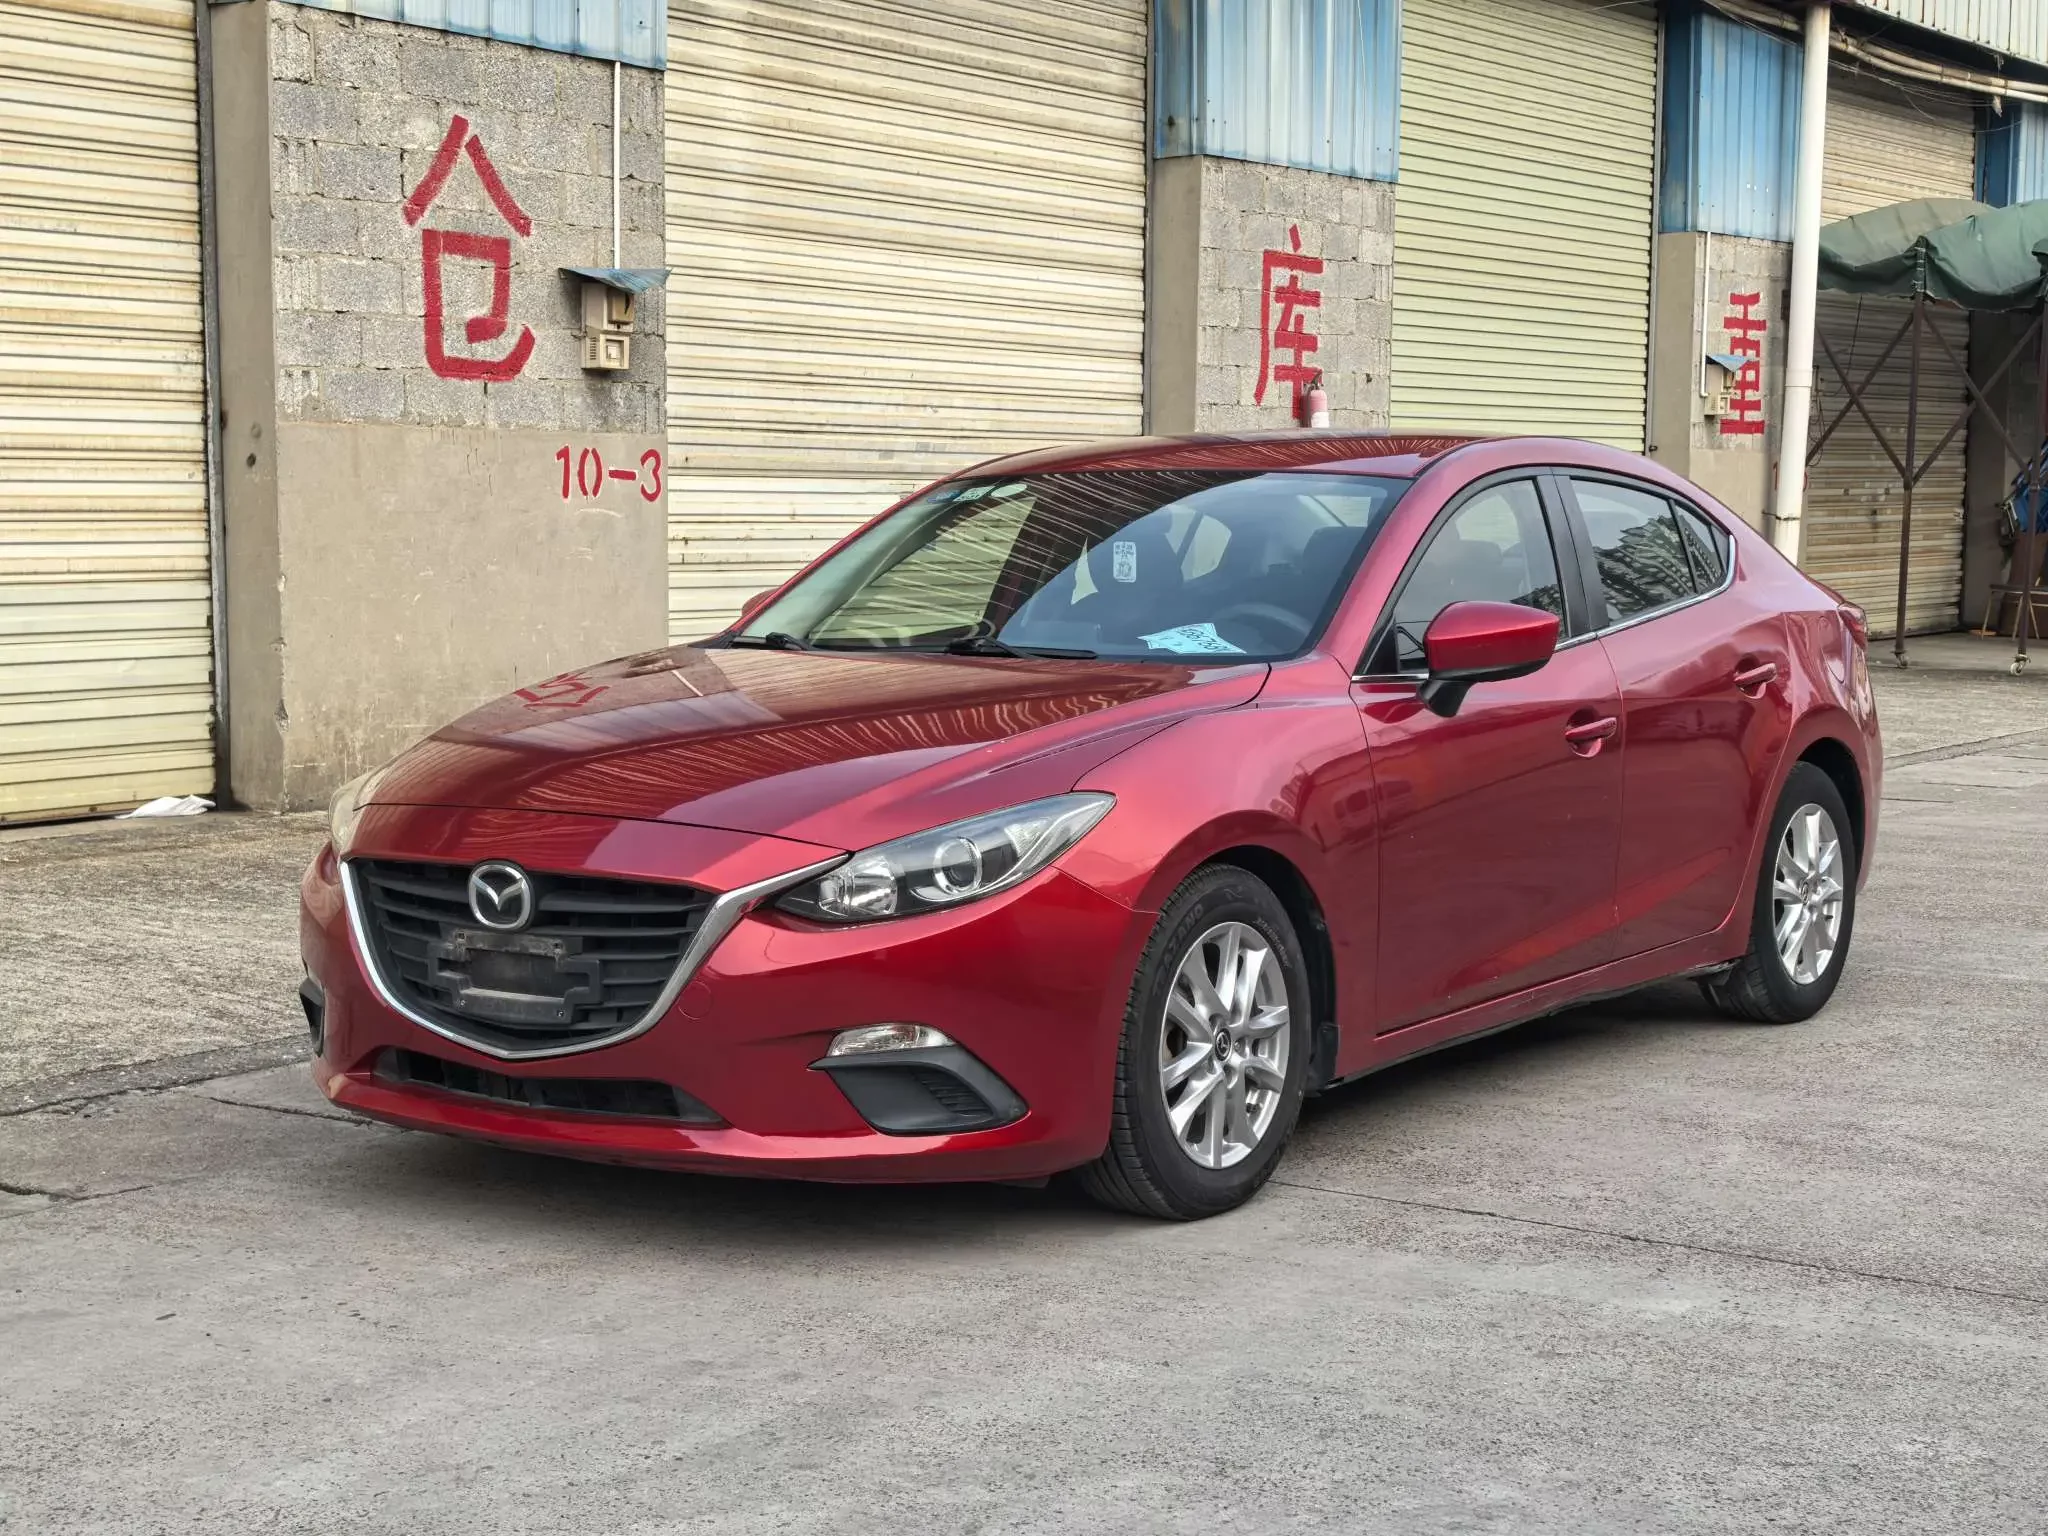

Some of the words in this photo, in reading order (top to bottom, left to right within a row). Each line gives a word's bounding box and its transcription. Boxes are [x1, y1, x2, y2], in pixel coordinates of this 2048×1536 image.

[403, 114, 535, 382] 仓
[1253, 223, 1324, 420] 库
[1720, 292, 1767, 435] 重
[555, 445, 663, 501] 10-3
